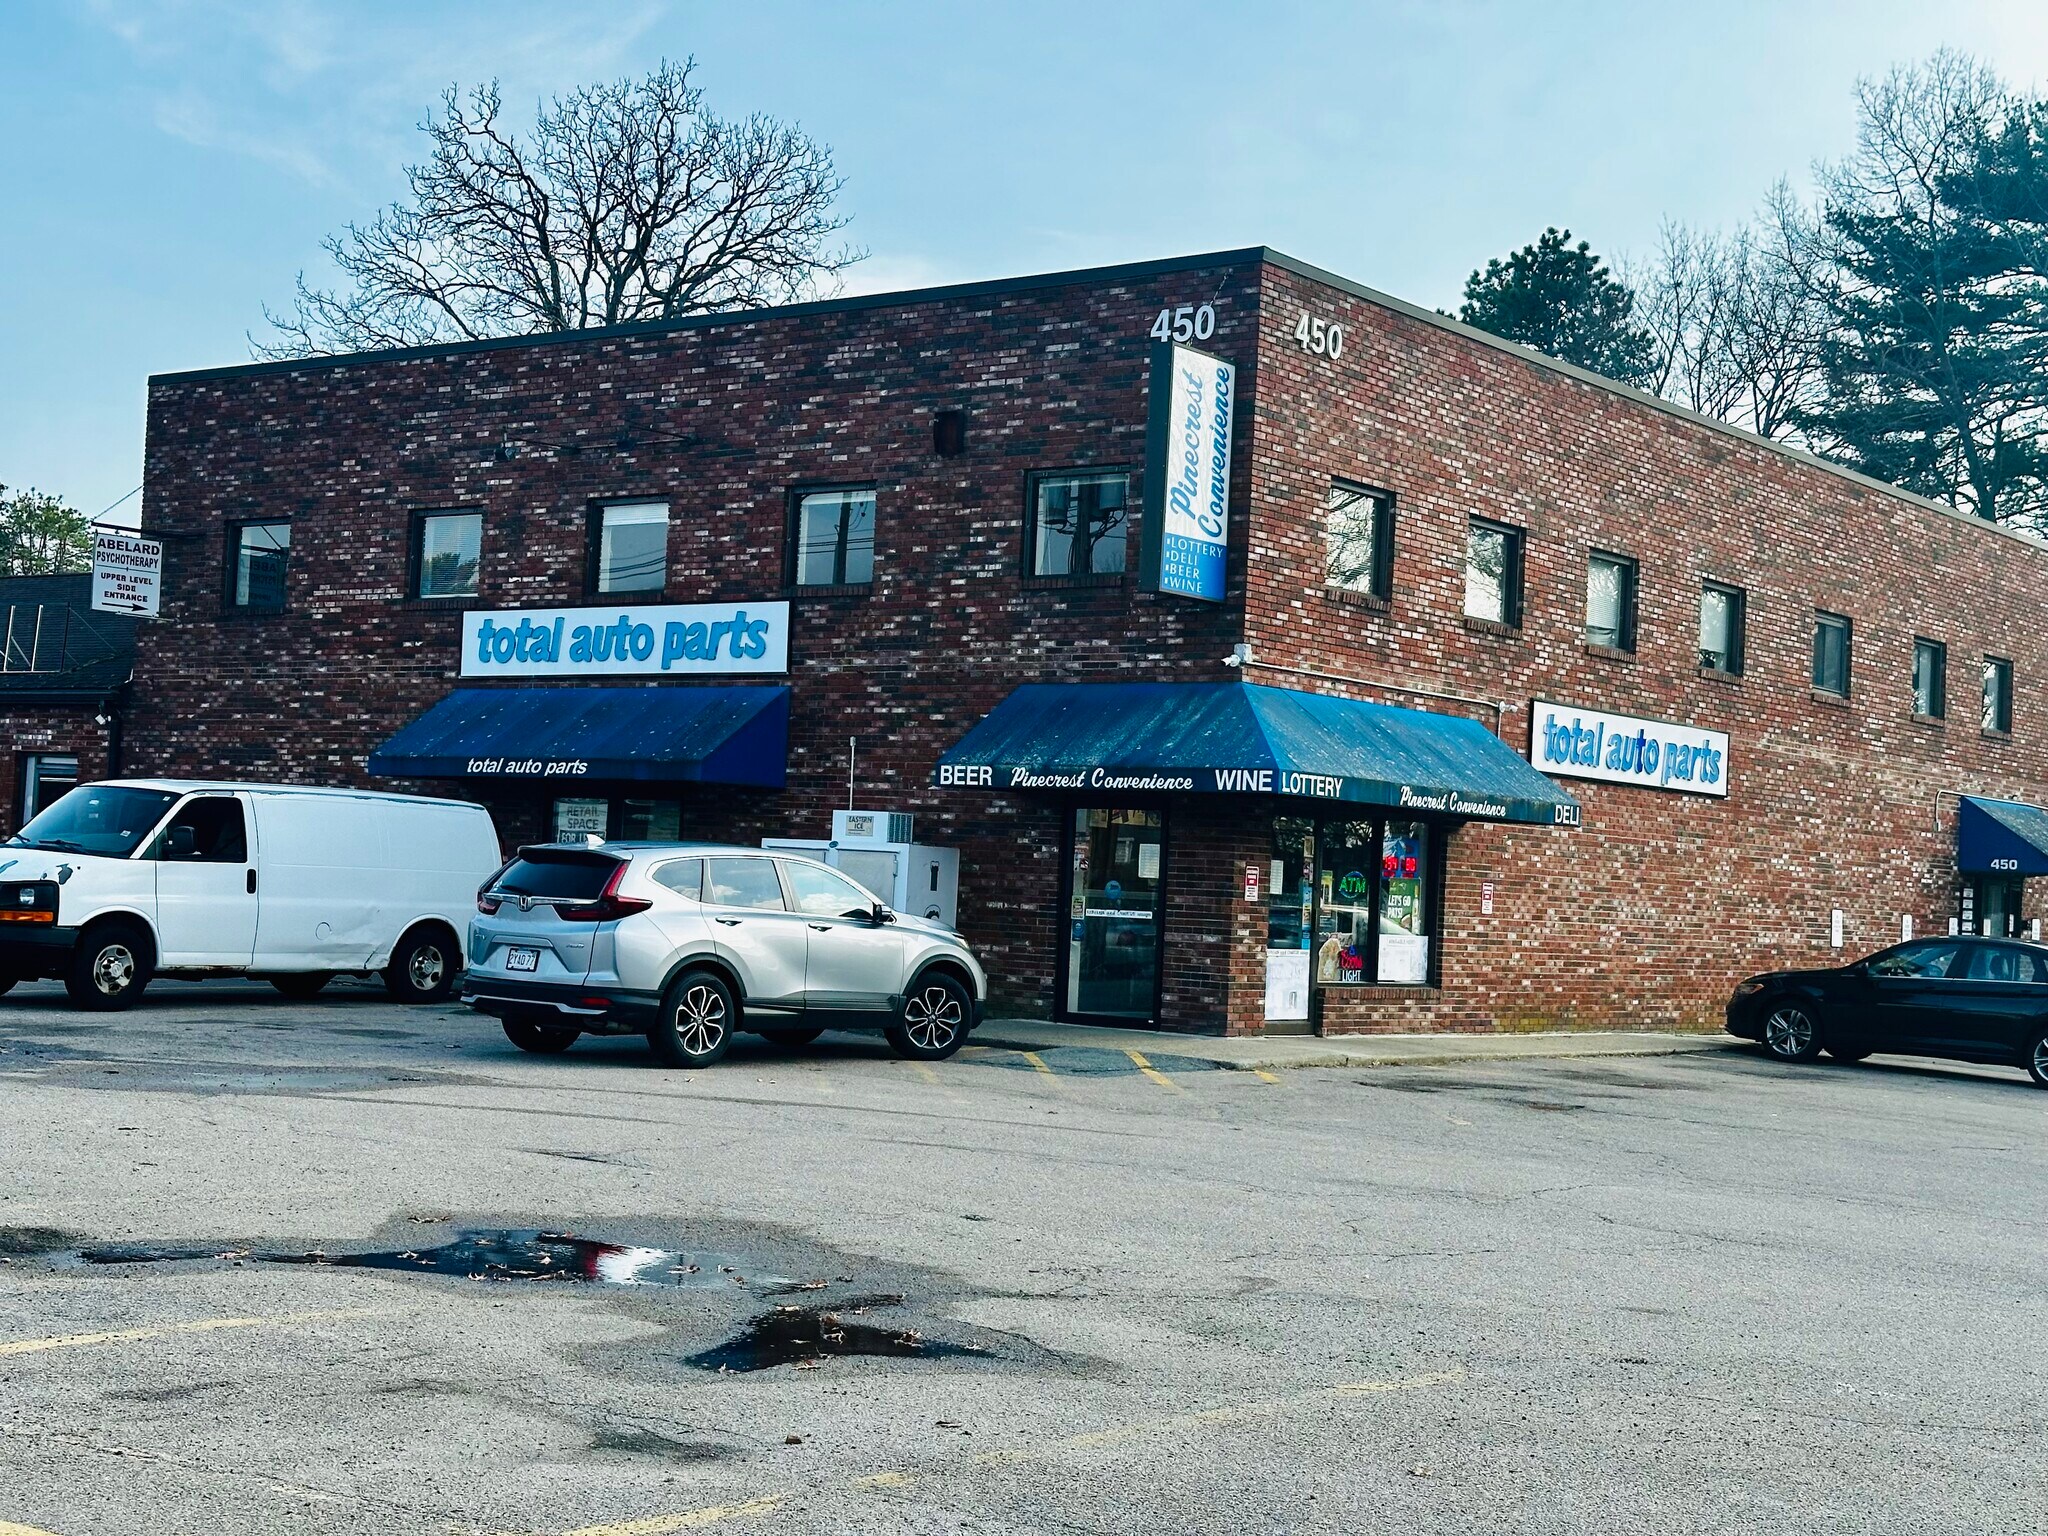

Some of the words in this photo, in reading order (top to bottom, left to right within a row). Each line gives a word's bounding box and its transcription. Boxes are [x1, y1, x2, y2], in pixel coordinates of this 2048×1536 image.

[1150, 305, 1216, 343] 450
[1294, 313, 1343, 361] 450
[1169, 367, 1203, 520] Pinecrest
[1197, 366, 1231, 538] Convenience
[97, 538, 160, 556] ABELARD
[1170, 537, 1224, 558] LOTTERY
[96, 551, 159, 569] PSYCHOTHERAPY
[1169, 551, 1199, 566] DELI
[100, 572, 127, 582] UPPER
[129, 576, 153, 585] LEVEL
[1169, 565, 1201, 579] BEER
[116, 583, 136, 592] SIDE
[1169, 577, 1203, 594] WINE
[104, 591, 148, 602] ENTRANCE
[478, 617, 565, 664] total
[569, 615, 655, 663] auto
[661, 611, 769, 670] parts
[1543, 714, 1605, 768] total
[1606, 729, 1660, 775] auto
[1661, 739, 1722, 786] parts
[467, 758, 504, 773] total
[505, 759, 542, 774] auto
[544, 759, 588, 776] parts
[939, 765, 992, 786] BEER
[1010, 767, 1085, 787] Pinecrest
[1091, 768, 1194, 790] Convenience
[1214, 769, 1273, 792] WINE
[1281, 771, 1344, 798] LOTTERY
[1400, 786, 1447, 810] Pinecrest
[1449, 793, 1507, 817] Convenience
[566, 806, 599, 817] RETAIL
[1554, 804, 1580, 826] DELI
[567, 818, 599, 829] SPACE
[1990, 859, 2018, 870] 450
[1338, 876, 1367, 893] ATM
[1402, 896, 1411, 906] GO
[1342, 969, 1361, 981] LIGHT
